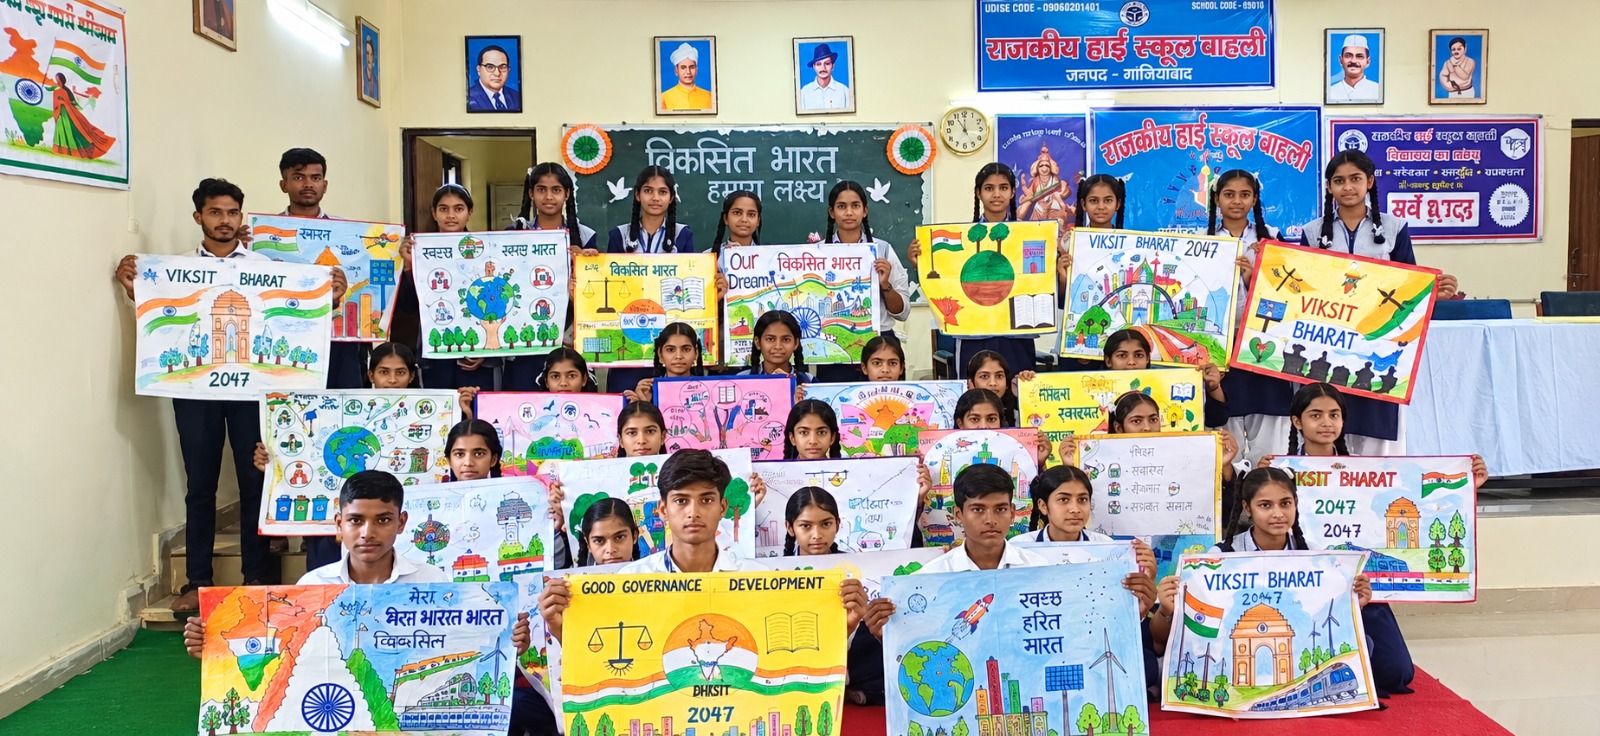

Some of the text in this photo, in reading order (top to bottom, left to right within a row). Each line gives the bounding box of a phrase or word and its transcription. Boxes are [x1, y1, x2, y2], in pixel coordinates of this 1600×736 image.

[985, 3, 1010, 12] UDISE
[1012, 3, 1034, 12] CODE
[1192, 1, 1218, 10] SCHOOL
[1220, 1, 1236, 10] CODE
[985, 28, 1081, 60] राजकीय
[1084, 27, 1129, 61] हाई
[1133, 35, 1197, 66] स्कूल
[1066, 68, 1108, 82] जनपद
[1099, 118, 1172, 166] राजकीय
[1175, 113, 1207, 150] हाई
[1209, 122, 1257, 160] स्कूल
[645, 137, 839, 174] विकसित भारत
[773, 179, 827, 202] लक्ष्य
[532, 243, 557, 255] भारत
[1088, 234, 1219, 259] VIKSIT BHARAT 2047
[609, 261, 648, 276] विकसित
[652, 264, 678, 276] भारत
[729, 252, 759, 271] Our
[777, 252, 863, 271] विकसित भारत
[165, 269, 287, 288] VIKSIT BHARAT
[727, 273, 768, 290] Dream
[1301, 295, 1358, 322] VIKSIT
[1292, 320, 1359, 350] BHARAT
[209, 371, 250, 387] 2047
[1339, 471, 1397, 487] BHARAT
[1315, 499, 1356, 514] 2047
[1323, 523, 1361, 538] 2047
[581, 576, 825, 594] GOOD GOVERNANCE DEVELOPMENT
[1203, 571, 1324, 591] VIKSIT BHARAT
[408, 586, 438, 604] मेरा
[466, 609, 504, 626] भारत
[1022, 610, 1062, 633] हरित
[687, 706, 735, 723] 2047
